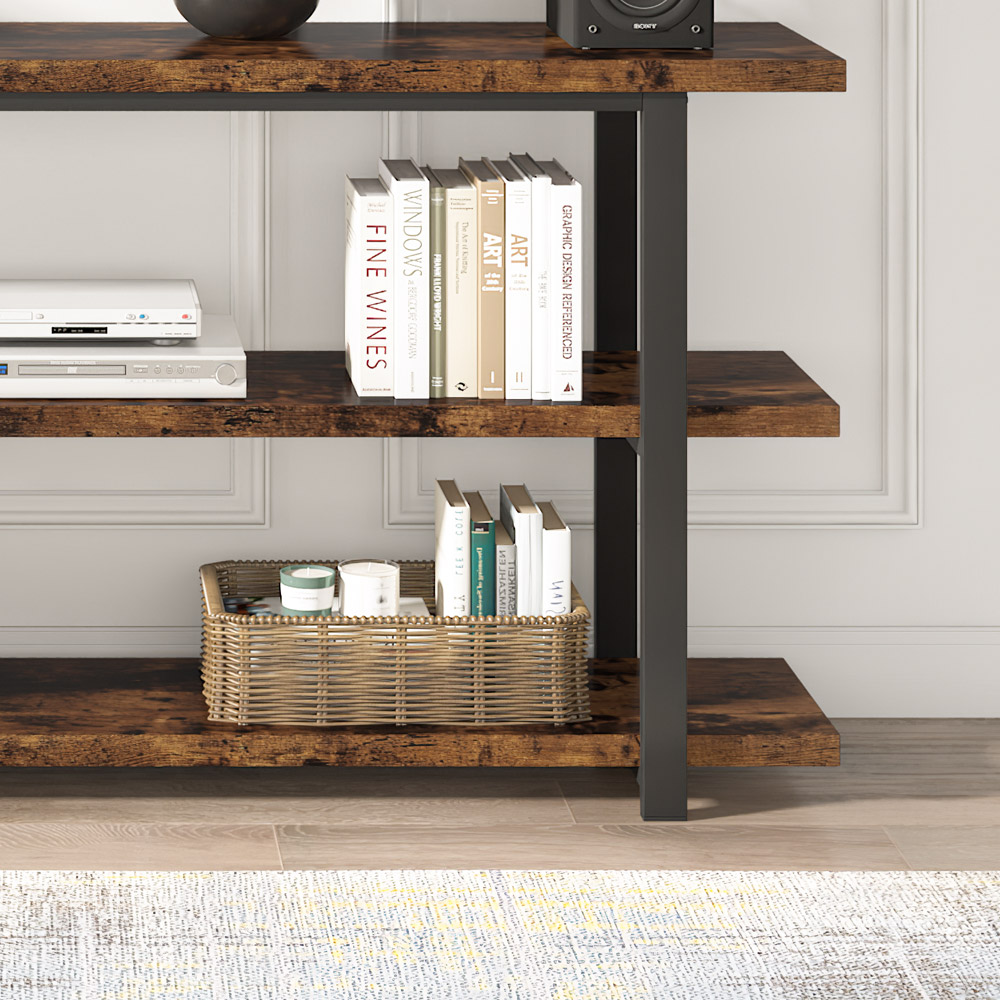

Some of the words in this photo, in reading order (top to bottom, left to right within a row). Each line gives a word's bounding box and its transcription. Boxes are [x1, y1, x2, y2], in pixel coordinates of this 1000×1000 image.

[403, 188, 423, 277] WINDOWS
[483, 232, 503, 268] ART
[511, 233, 529, 267] ART
[562, 205, 573, 250] GRAPHIC
[366, 225, 387, 277] FINE
[562, 253, 573, 290] DESIGN
[433, 278, 442, 302] LLOYD
[366, 290, 387, 369] WINES
[562, 293, 573, 360] REFERENCED
